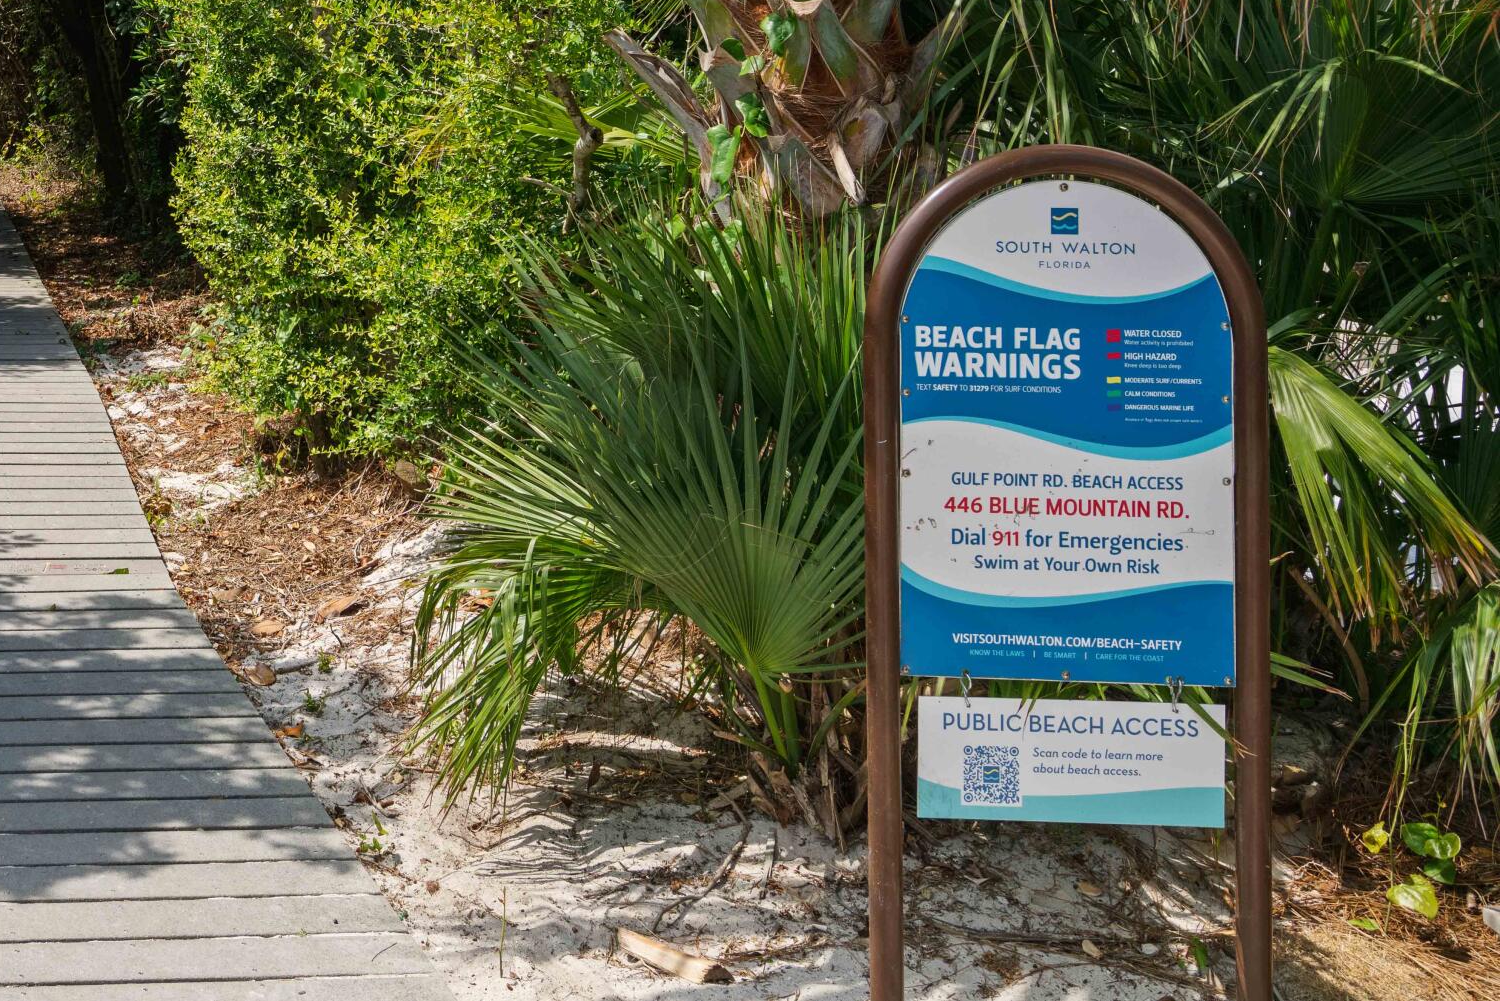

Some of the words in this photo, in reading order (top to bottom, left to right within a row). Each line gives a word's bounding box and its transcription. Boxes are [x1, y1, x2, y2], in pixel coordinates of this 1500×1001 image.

[996, 241, 1052, 254] SOUTH
[1063, 242, 1136, 255] WALTON
[1039, 261, 1091, 269] FLORIDA
[915, 325, 1002, 349] BEACH
[1014, 328, 1081, 350] FLAG
[1152, 330, 1181, 338] CLOSED
[915, 352, 1081, 379] WARNINGS
[951, 472, 989, 486] GULF
[994, 473, 1038, 487] POINT
[1043, 474, 1068, 488] RD.
[1073, 475, 1122, 489] BEACH
[1128, 476, 1183, 490] ACCESS
[944, 497, 982, 513] 446
[989, 497, 1039, 515] BLUE
[1046, 499, 1151, 518] MOUNTAIN
[1157, 502, 1189, 519] RD.
[951, 528, 985, 546] Dial
[993, 530, 1019, 546] 911
[1025, 529, 1051, 548] for
[1059, 532, 1183, 554] Emergencies
[974, 555, 1018, 569] Swim
[1023, 558, 1039, 570] at
[1044, 558, 1080, 572] Your
[1085, 559, 1122, 573] Own
[1127, 559, 1159, 574] Risk
[953, 633, 1182, 651] VISITSOUTHWALTON.COM/BEACH-SAFETY
[943, 712, 1022, 731] PUBLIC
[1029, 715, 1103, 735] BEACH
[1112, 718, 1199, 737] ACCESS
[1032, 748, 1059, 758] Scan
[1062, 748, 1087, 759] code
[1091, 750, 1102, 760] to
[1105, 750, 1132, 760] learn
[1135, 752, 1163, 761] more
[1033, 763, 1064, 774] about
[1067, 764, 1100, 775] beach
[1103, 767, 1141, 776] access.
